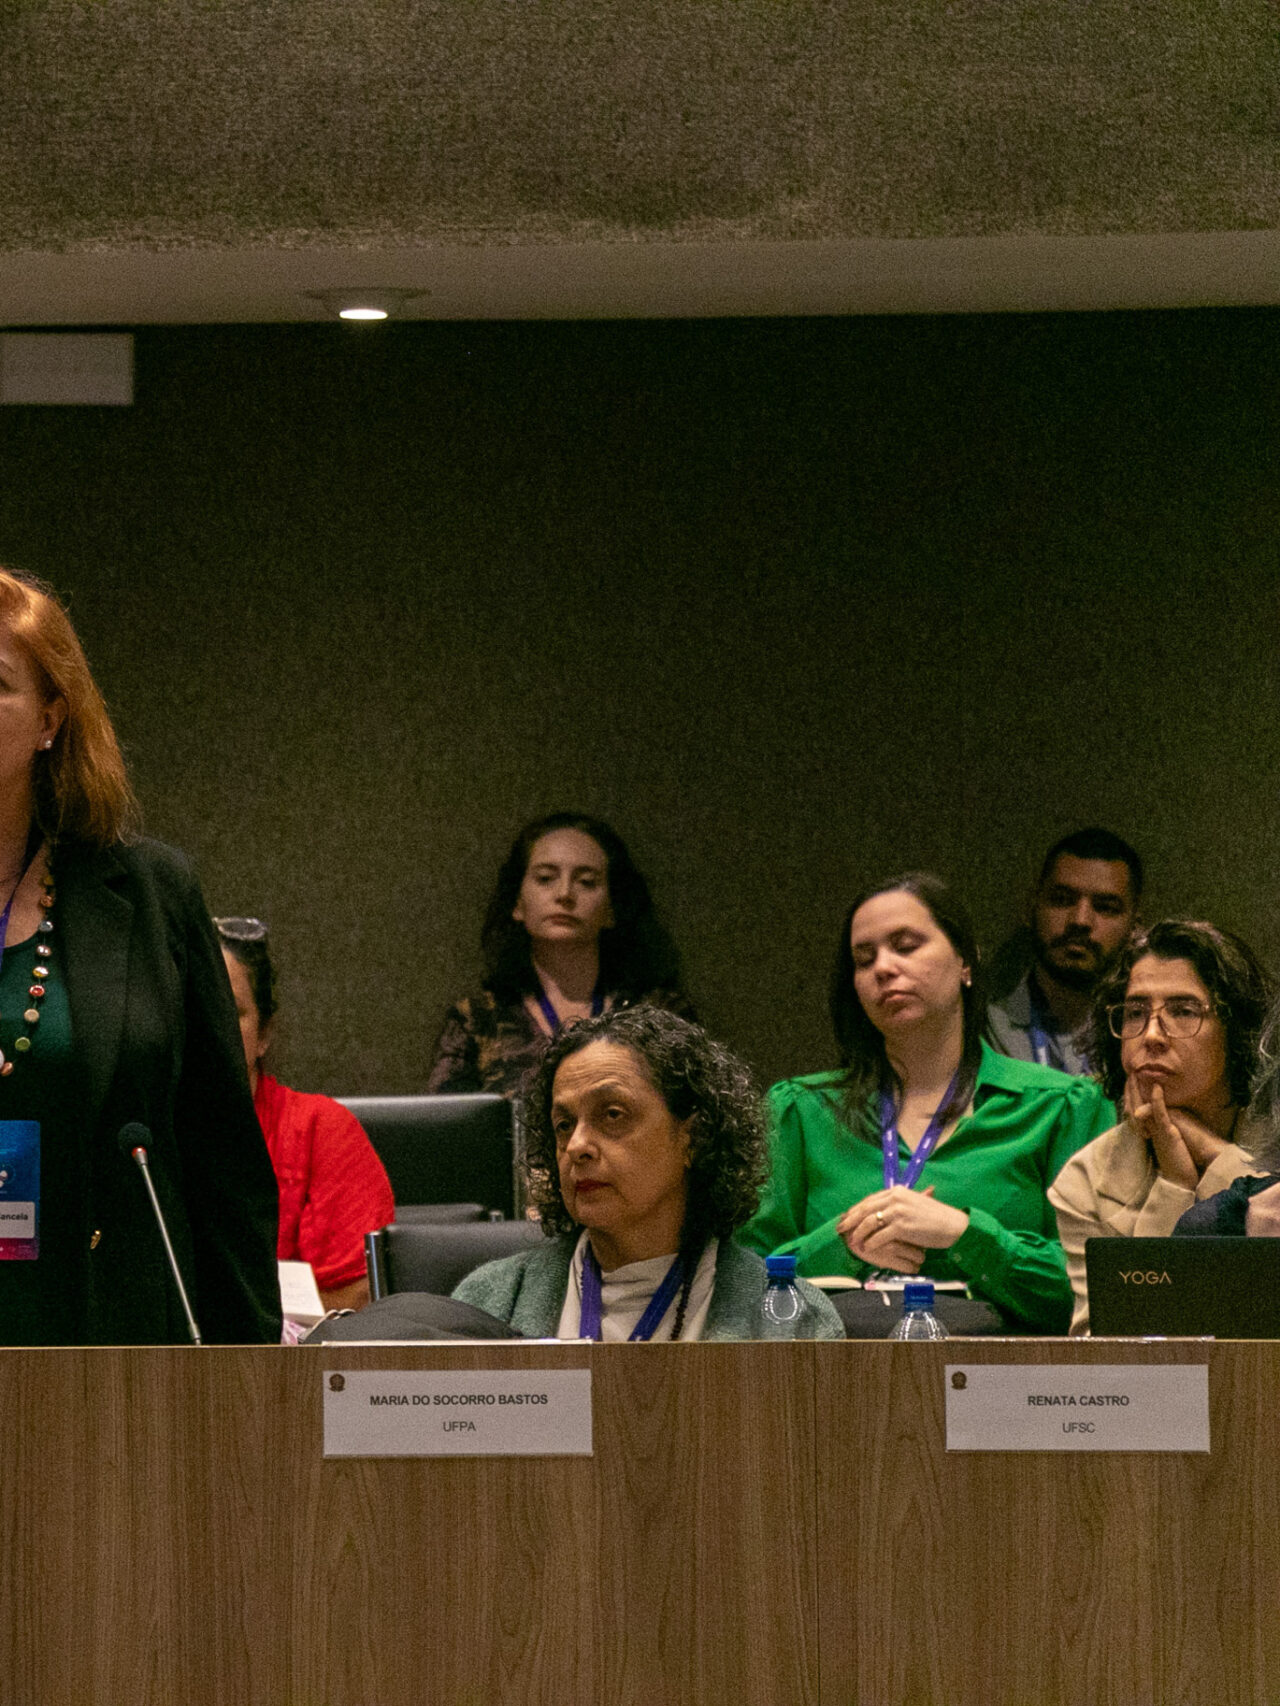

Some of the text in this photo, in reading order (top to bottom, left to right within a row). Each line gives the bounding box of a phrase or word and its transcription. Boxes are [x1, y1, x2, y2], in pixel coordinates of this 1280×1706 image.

[1119, 1271, 1171, 1285] YOGA
[369, 1393, 549, 1407] MARIA DO SOCORRO BASTOS
[1027, 1394, 1130, 1407] RENATA CASTRO
[442, 1420, 477, 1433] UFPA
[1061, 1421, 1096, 1434] UFSC
